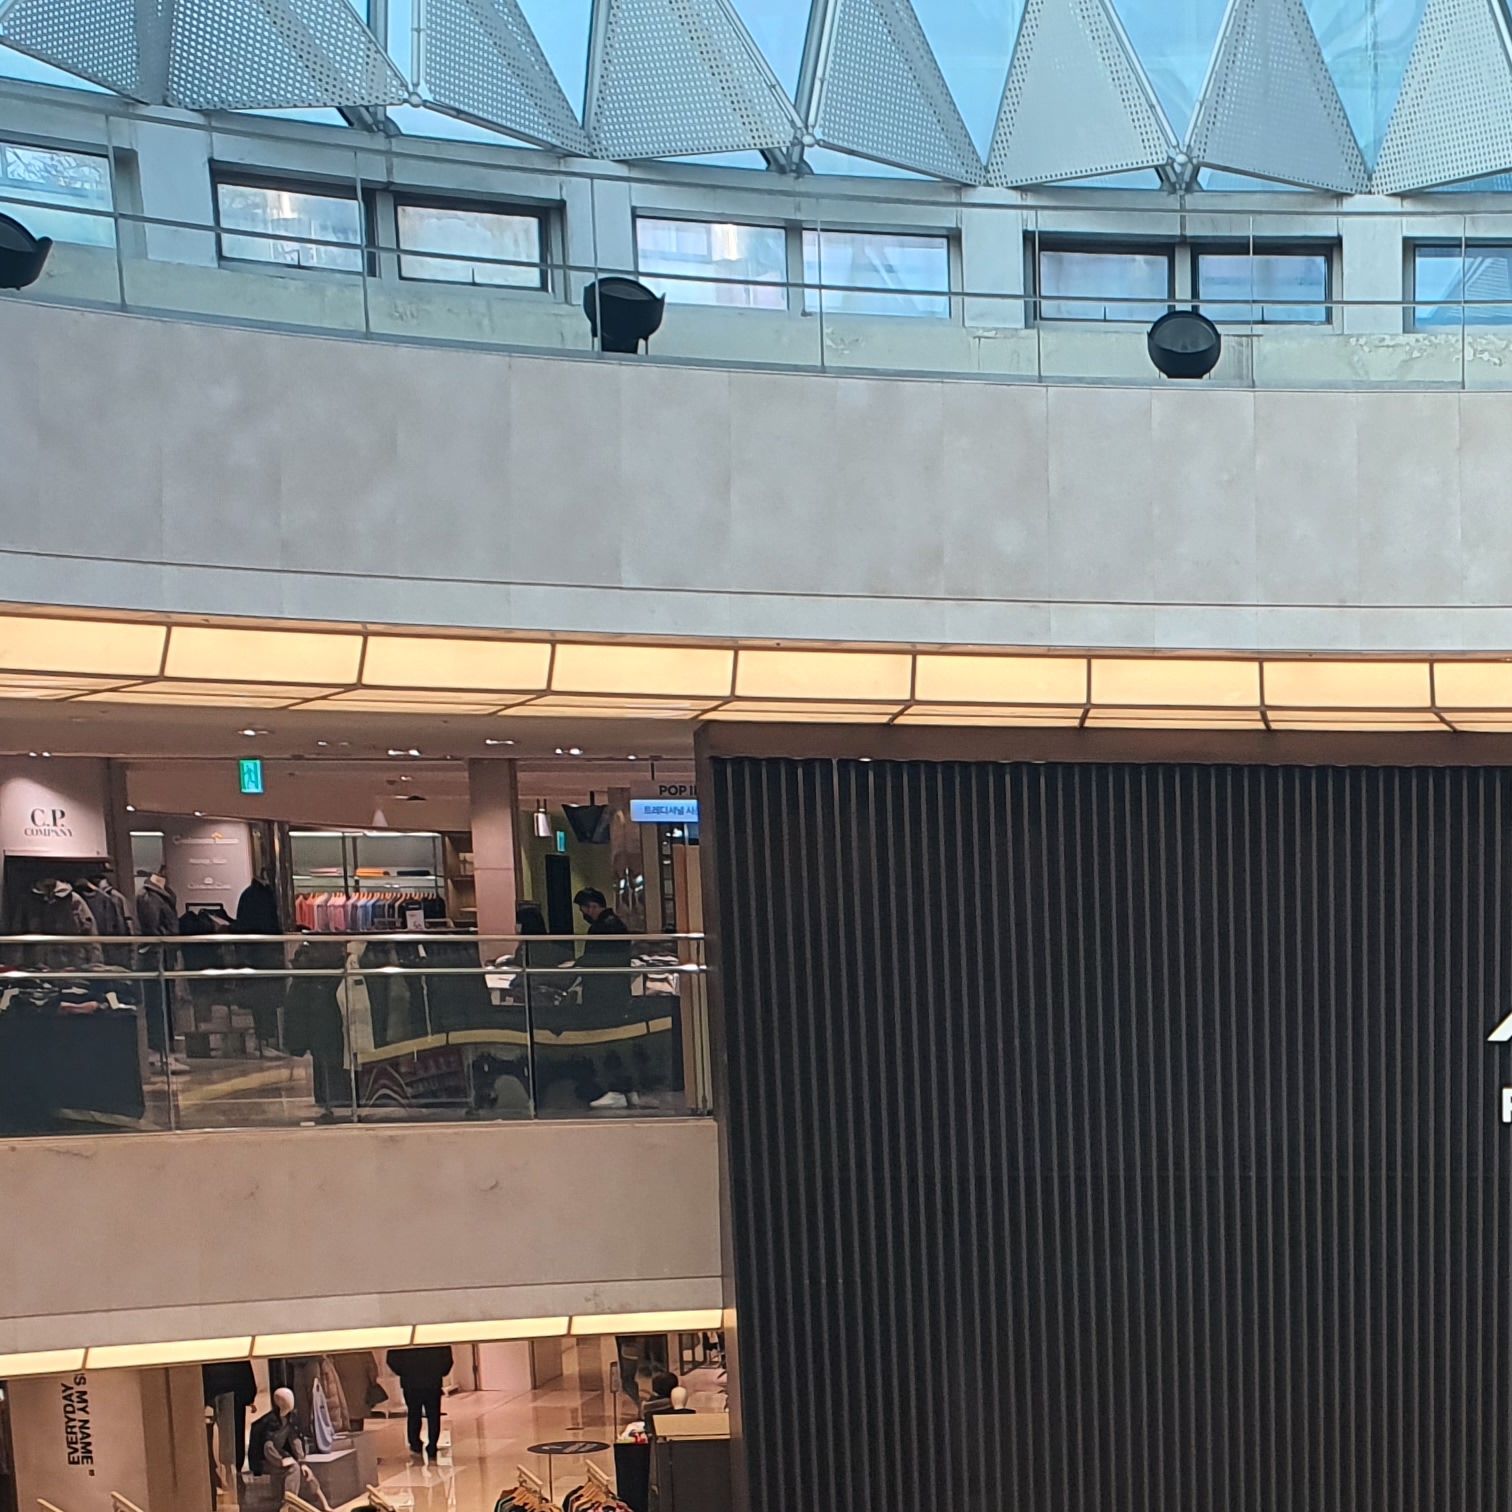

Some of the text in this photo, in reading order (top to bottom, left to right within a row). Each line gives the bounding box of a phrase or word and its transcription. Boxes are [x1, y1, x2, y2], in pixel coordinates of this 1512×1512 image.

[658, 784, 687, 796] POP
[30, 807, 66, 828] C.P.
[24, 827, 73, 838] COMPANY
[75, 1390, 90, 1415] MY
[61, 1382, 81, 1465] EVERYDAY
